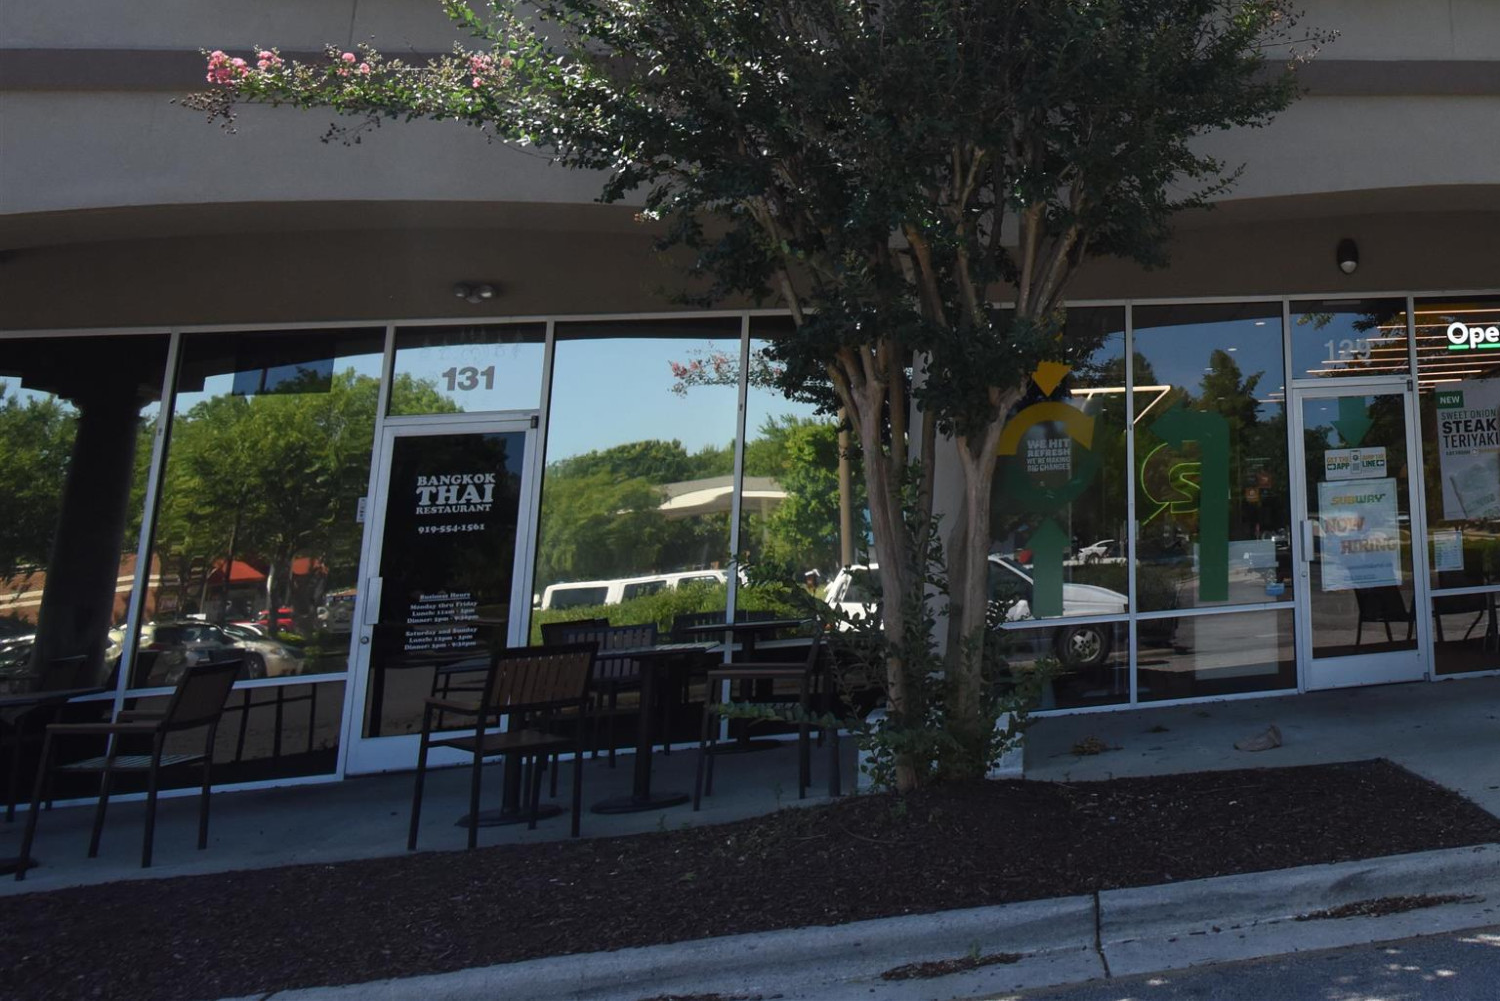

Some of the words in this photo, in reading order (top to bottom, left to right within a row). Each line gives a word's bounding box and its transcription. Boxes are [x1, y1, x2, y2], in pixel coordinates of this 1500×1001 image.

[1324, 339, 1371, 361] 129
[442, 365, 496, 392] 131
[1440, 395, 1460, 404] NEW
[1441, 411, 1468, 420] SWEET
[1470, 409, 1497, 418] ONION
[1442, 418, 1498, 434] STEAK
[1027, 439, 1047, 449] WE
[1048, 438, 1071, 449] HIT
[1442, 432, 1500, 448] TERIYAKI
[1027, 448, 1071, 457] REFRESH
[1336, 462, 1350, 470] APP
[1362, 460, 1376, 468] LINE
[417, 473, 496, 487] BANGKOK
[416, 484, 495, 506] THAI
[1331, 494, 1386, 506] SUBWAY
[416, 503, 492, 515] RESTAURANT
[418, 523, 485, 534] 919-554-1561
